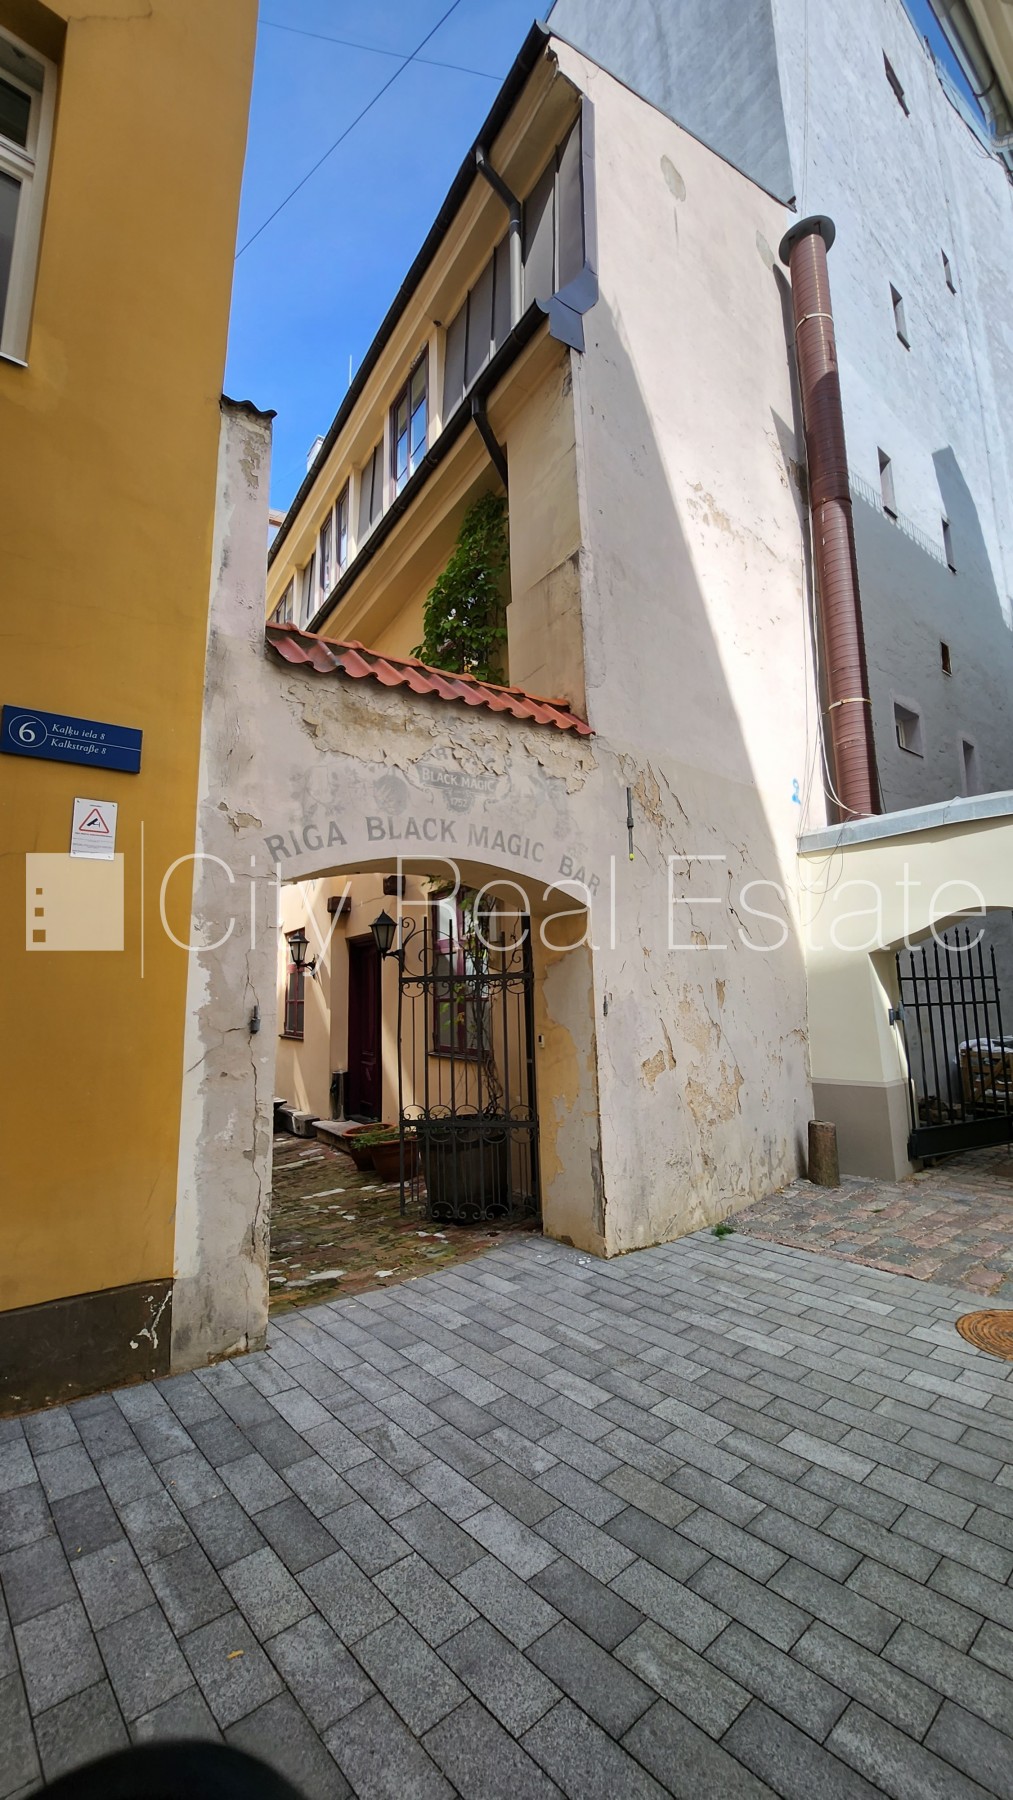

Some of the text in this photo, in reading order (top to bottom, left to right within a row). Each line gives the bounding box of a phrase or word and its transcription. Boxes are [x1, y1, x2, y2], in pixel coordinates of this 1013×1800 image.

[19, 721, 37, 743] 6
[52, 723, 79, 736] Kaļķu
[81, 729, 98, 739] iela
[51, 738, 107, 755] Kalkstraße 8
[422, 767, 495, 792] BLACK MAGIC
[263, 815, 601, 897] RIGA BLACK MAGIC BAR
